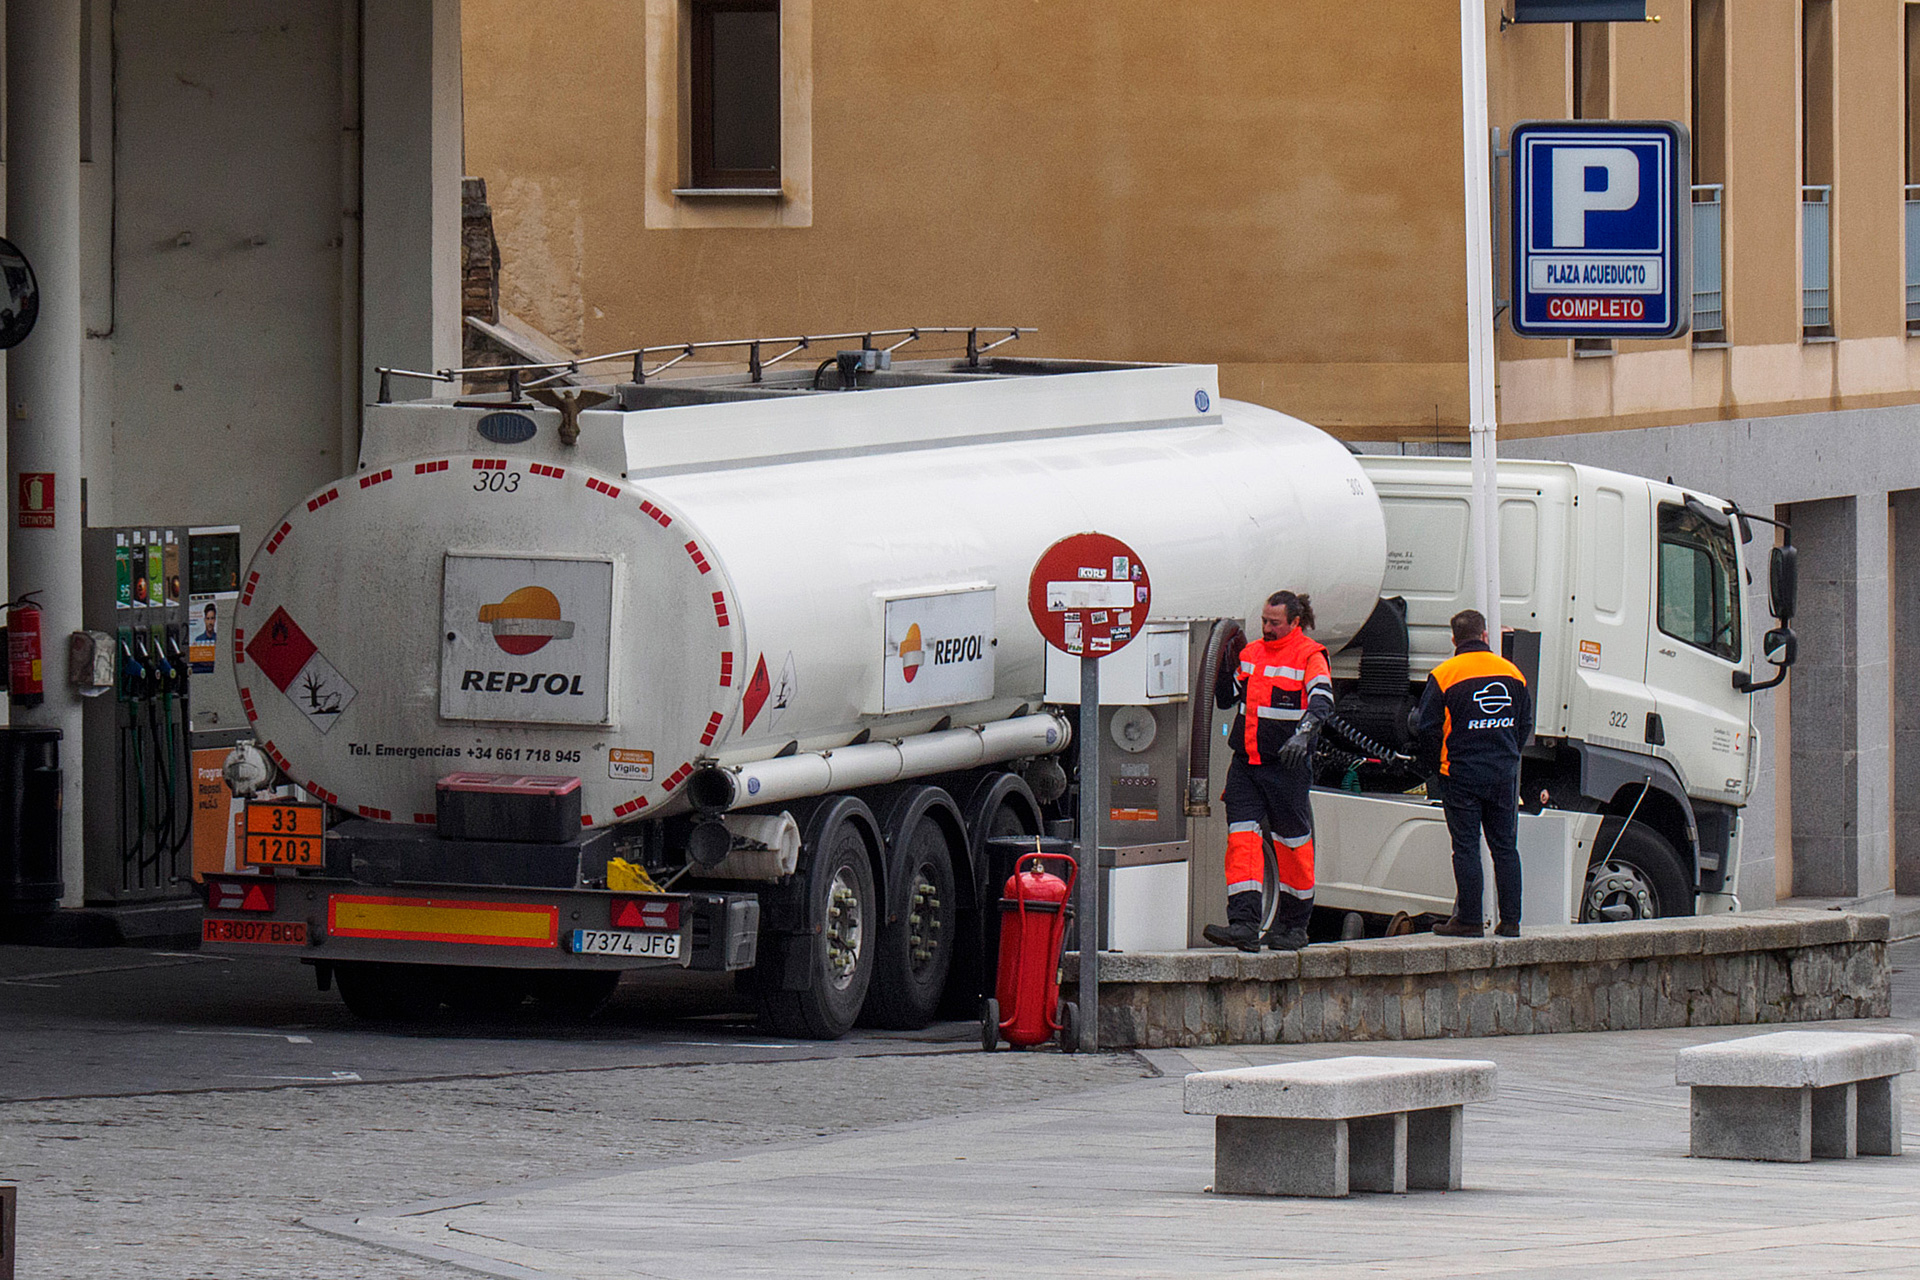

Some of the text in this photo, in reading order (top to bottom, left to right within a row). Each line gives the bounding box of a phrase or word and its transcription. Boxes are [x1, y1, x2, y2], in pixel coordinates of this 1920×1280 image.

[1553, 148, 1639, 247] P
[1547, 265, 1646, 284] PLAZA ACUEDUCTO
[1550, 299, 1644, 317] COMPLETO
[473, 471, 520, 493] 303
[20, 515, 53, 525] EXTINTOR
[934, 635, 982, 665] REPSOL
[461, 670, 584, 696] REPSOL
[1468, 717, 1515, 730] REPSOL
[1609, 710, 1628, 728] 322
[348, 743, 581, 763] Tel. Emergencias +34 661 718 945
[614, 763, 641, 774] Vigilo
[272, 809, 297, 832] 33
[259, 839, 311, 863] 1203
[223, 922, 266, 940] 3007
[586, 932, 675, 955] 7374 JFG
